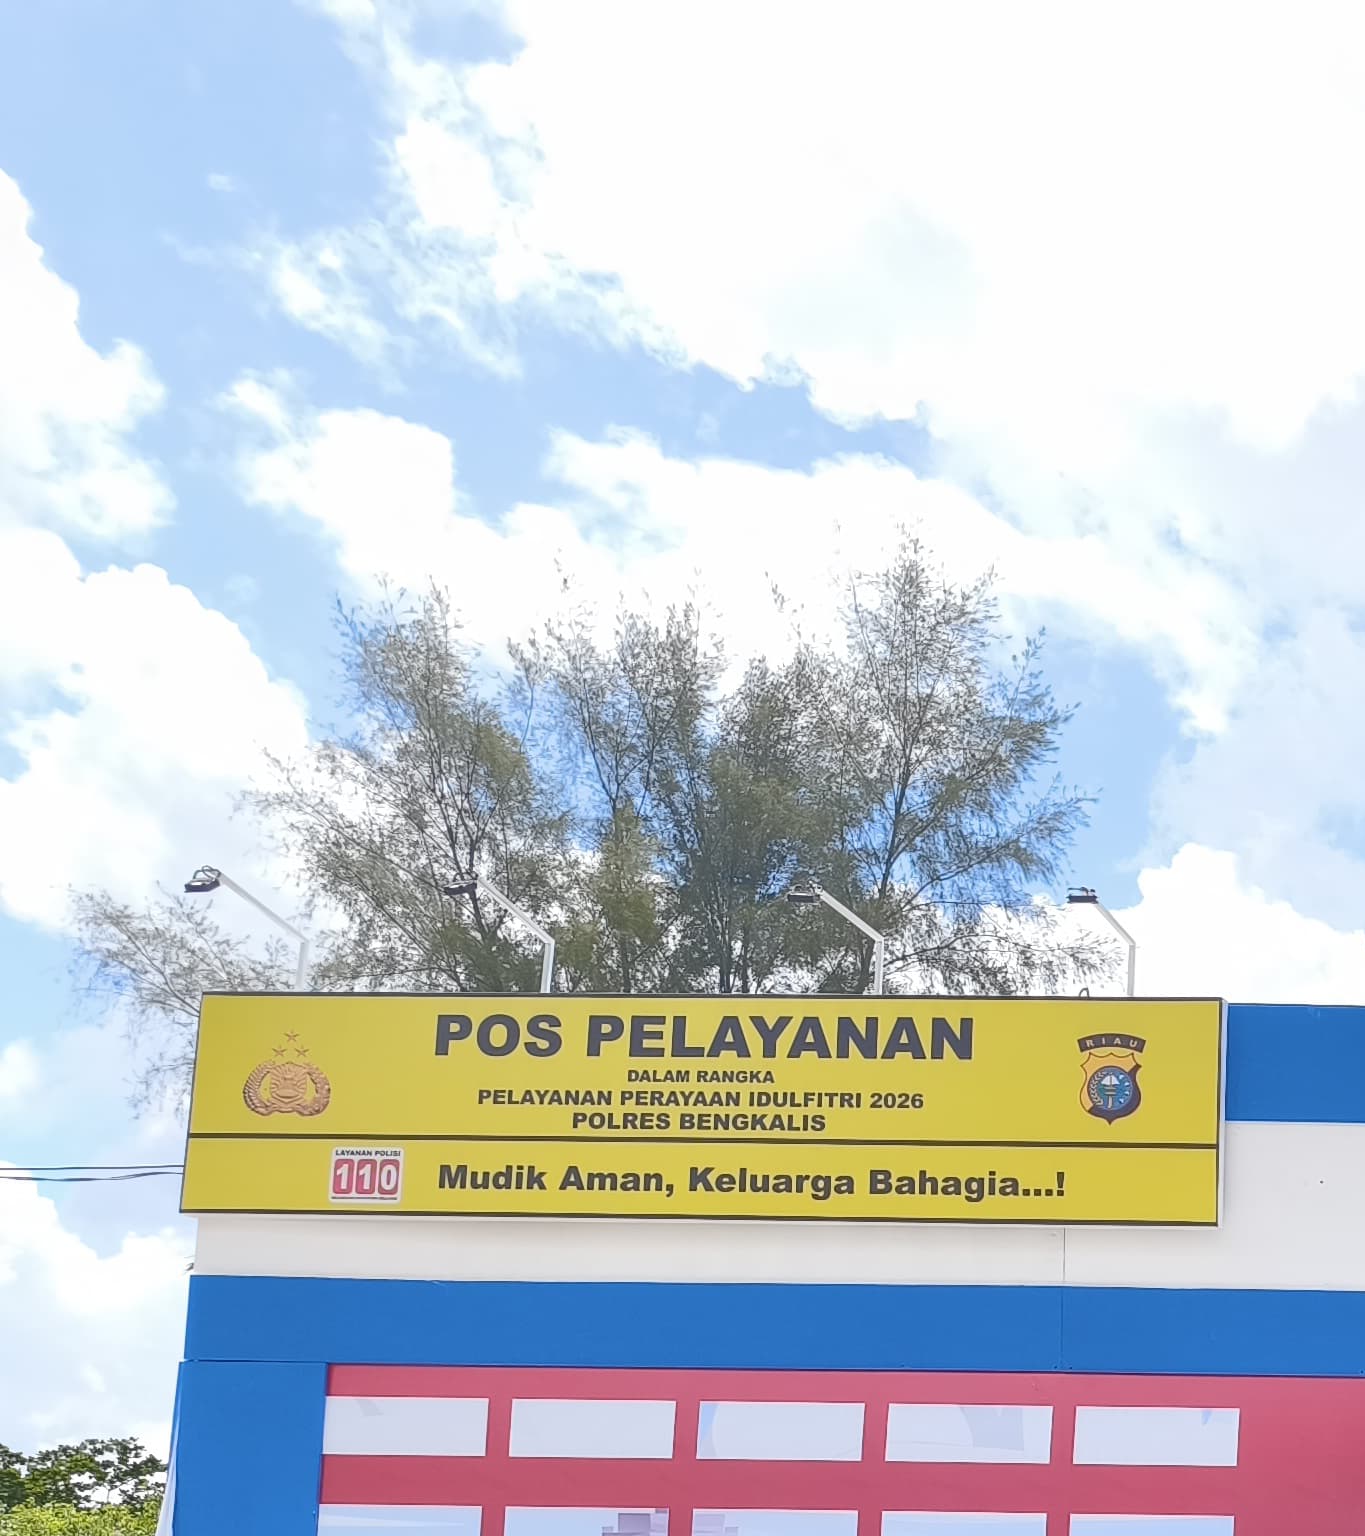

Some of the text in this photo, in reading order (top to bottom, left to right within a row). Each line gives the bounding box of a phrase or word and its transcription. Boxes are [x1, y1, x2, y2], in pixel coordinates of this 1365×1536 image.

[434, 1014, 974, 1060] POS PELAYANAN
[1085, 1037, 1138, 1048] RIAU
[627, 1069, 775, 1084] DALAM RANGKA
[478, 1089, 924, 1109] PELAYANAN PERAYAAN IDULFITRI 2026
[572, 1112, 826, 1132] POLRES BENGKALIS
[335, 1149, 372, 1157] LAYANAN
[335, 1162, 398, 1191] 110
[438, 1164, 1065, 1203] Mudik Aman, Keluarga Bahagia...!
